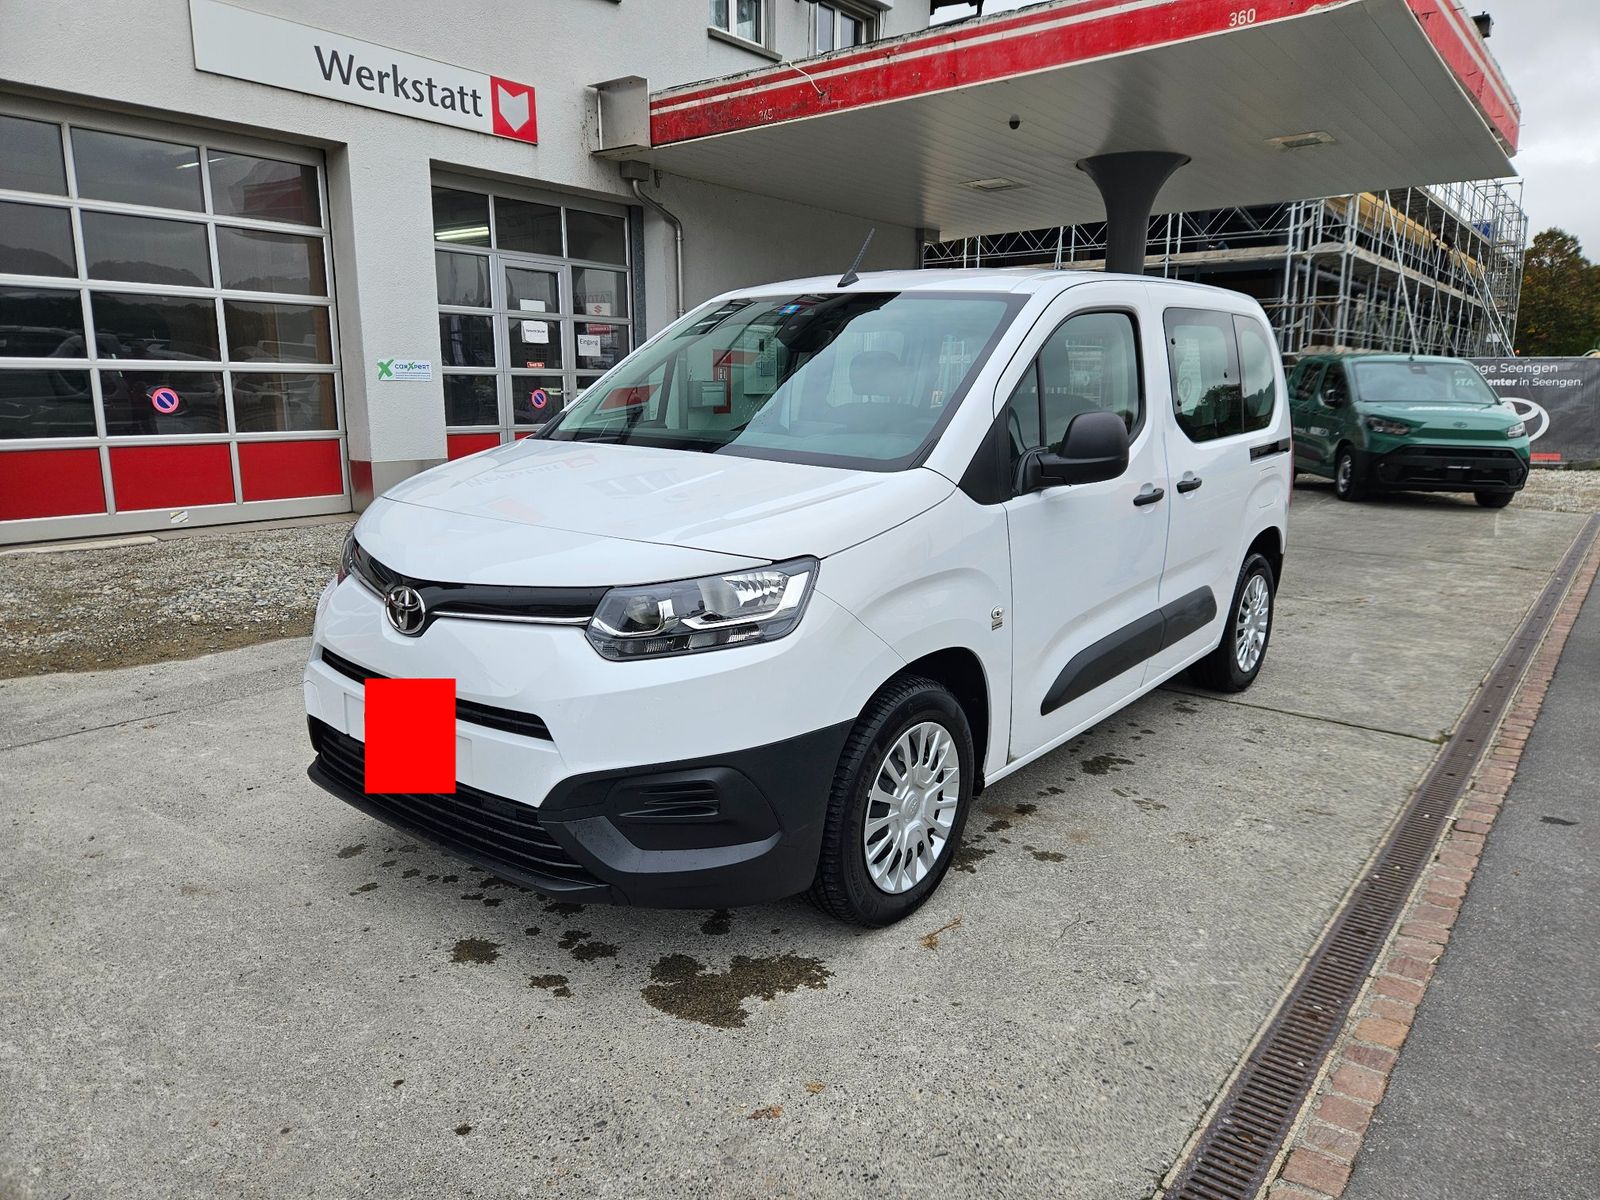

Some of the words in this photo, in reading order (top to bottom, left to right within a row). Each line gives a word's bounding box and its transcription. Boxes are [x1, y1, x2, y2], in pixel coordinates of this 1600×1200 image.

[1228, 8, 1256, 27] 360
[314, 45, 483, 117] Werkstatt
[1499, 363, 1558, 375] Seengen
[1487, 377, 1517, 386] enter
[1519, 377, 1529, 386] in
[1532, 377, 1583, 388] Seengen.
